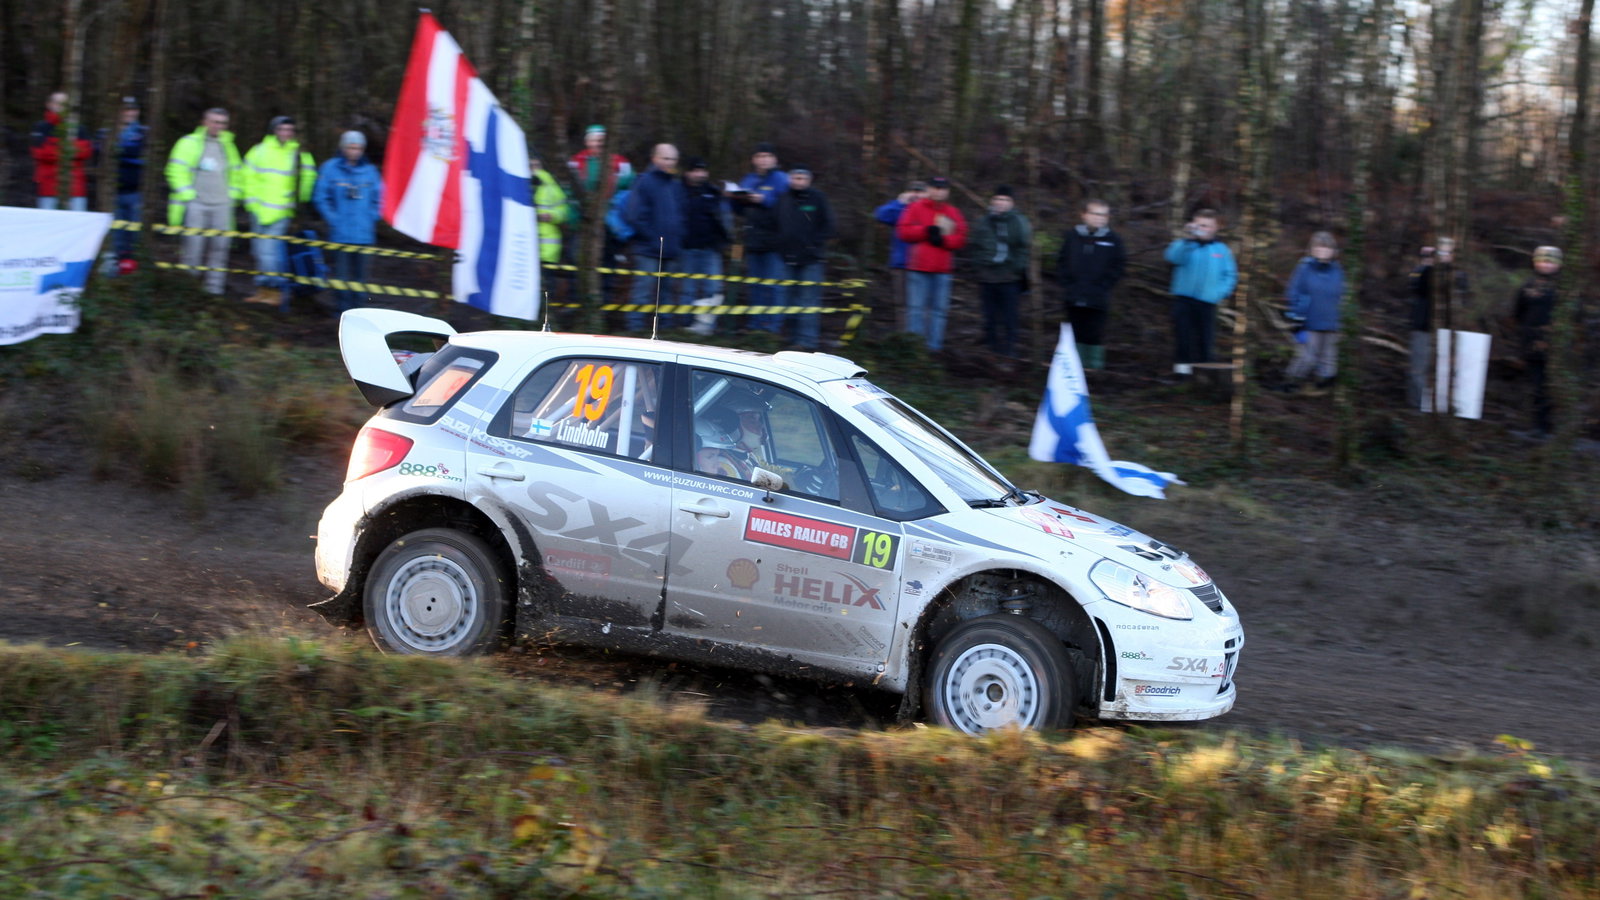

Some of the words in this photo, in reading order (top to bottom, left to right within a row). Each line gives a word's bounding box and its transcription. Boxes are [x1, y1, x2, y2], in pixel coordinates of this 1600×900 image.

[573, 364, 614, 421] 19
[556, 419, 609, 449] Lindholm
[489, 438, 533, 460] SPORT
[399, 462, 463, 482] 888.com
[644, 471, 754, 499] WWW.SUZUKI-WRC.COM
[510, 481, 694, 576] SX4
[751, 517, 792, 538] WALES
[793, 525, 830, 545] RALLY
[830, 533, 848, 549] GB
[863, 532, 892, 568] 19
[776, 563, 808, 575] Shell
[773, 572, 882, 610] HELIX
[773, 596, 810, 609] Motor
[812, 601, 833, 613] oils
[1166, 656, 1208, 673] SX4
[1135, 685, 1181, 694] BFGoodrich
